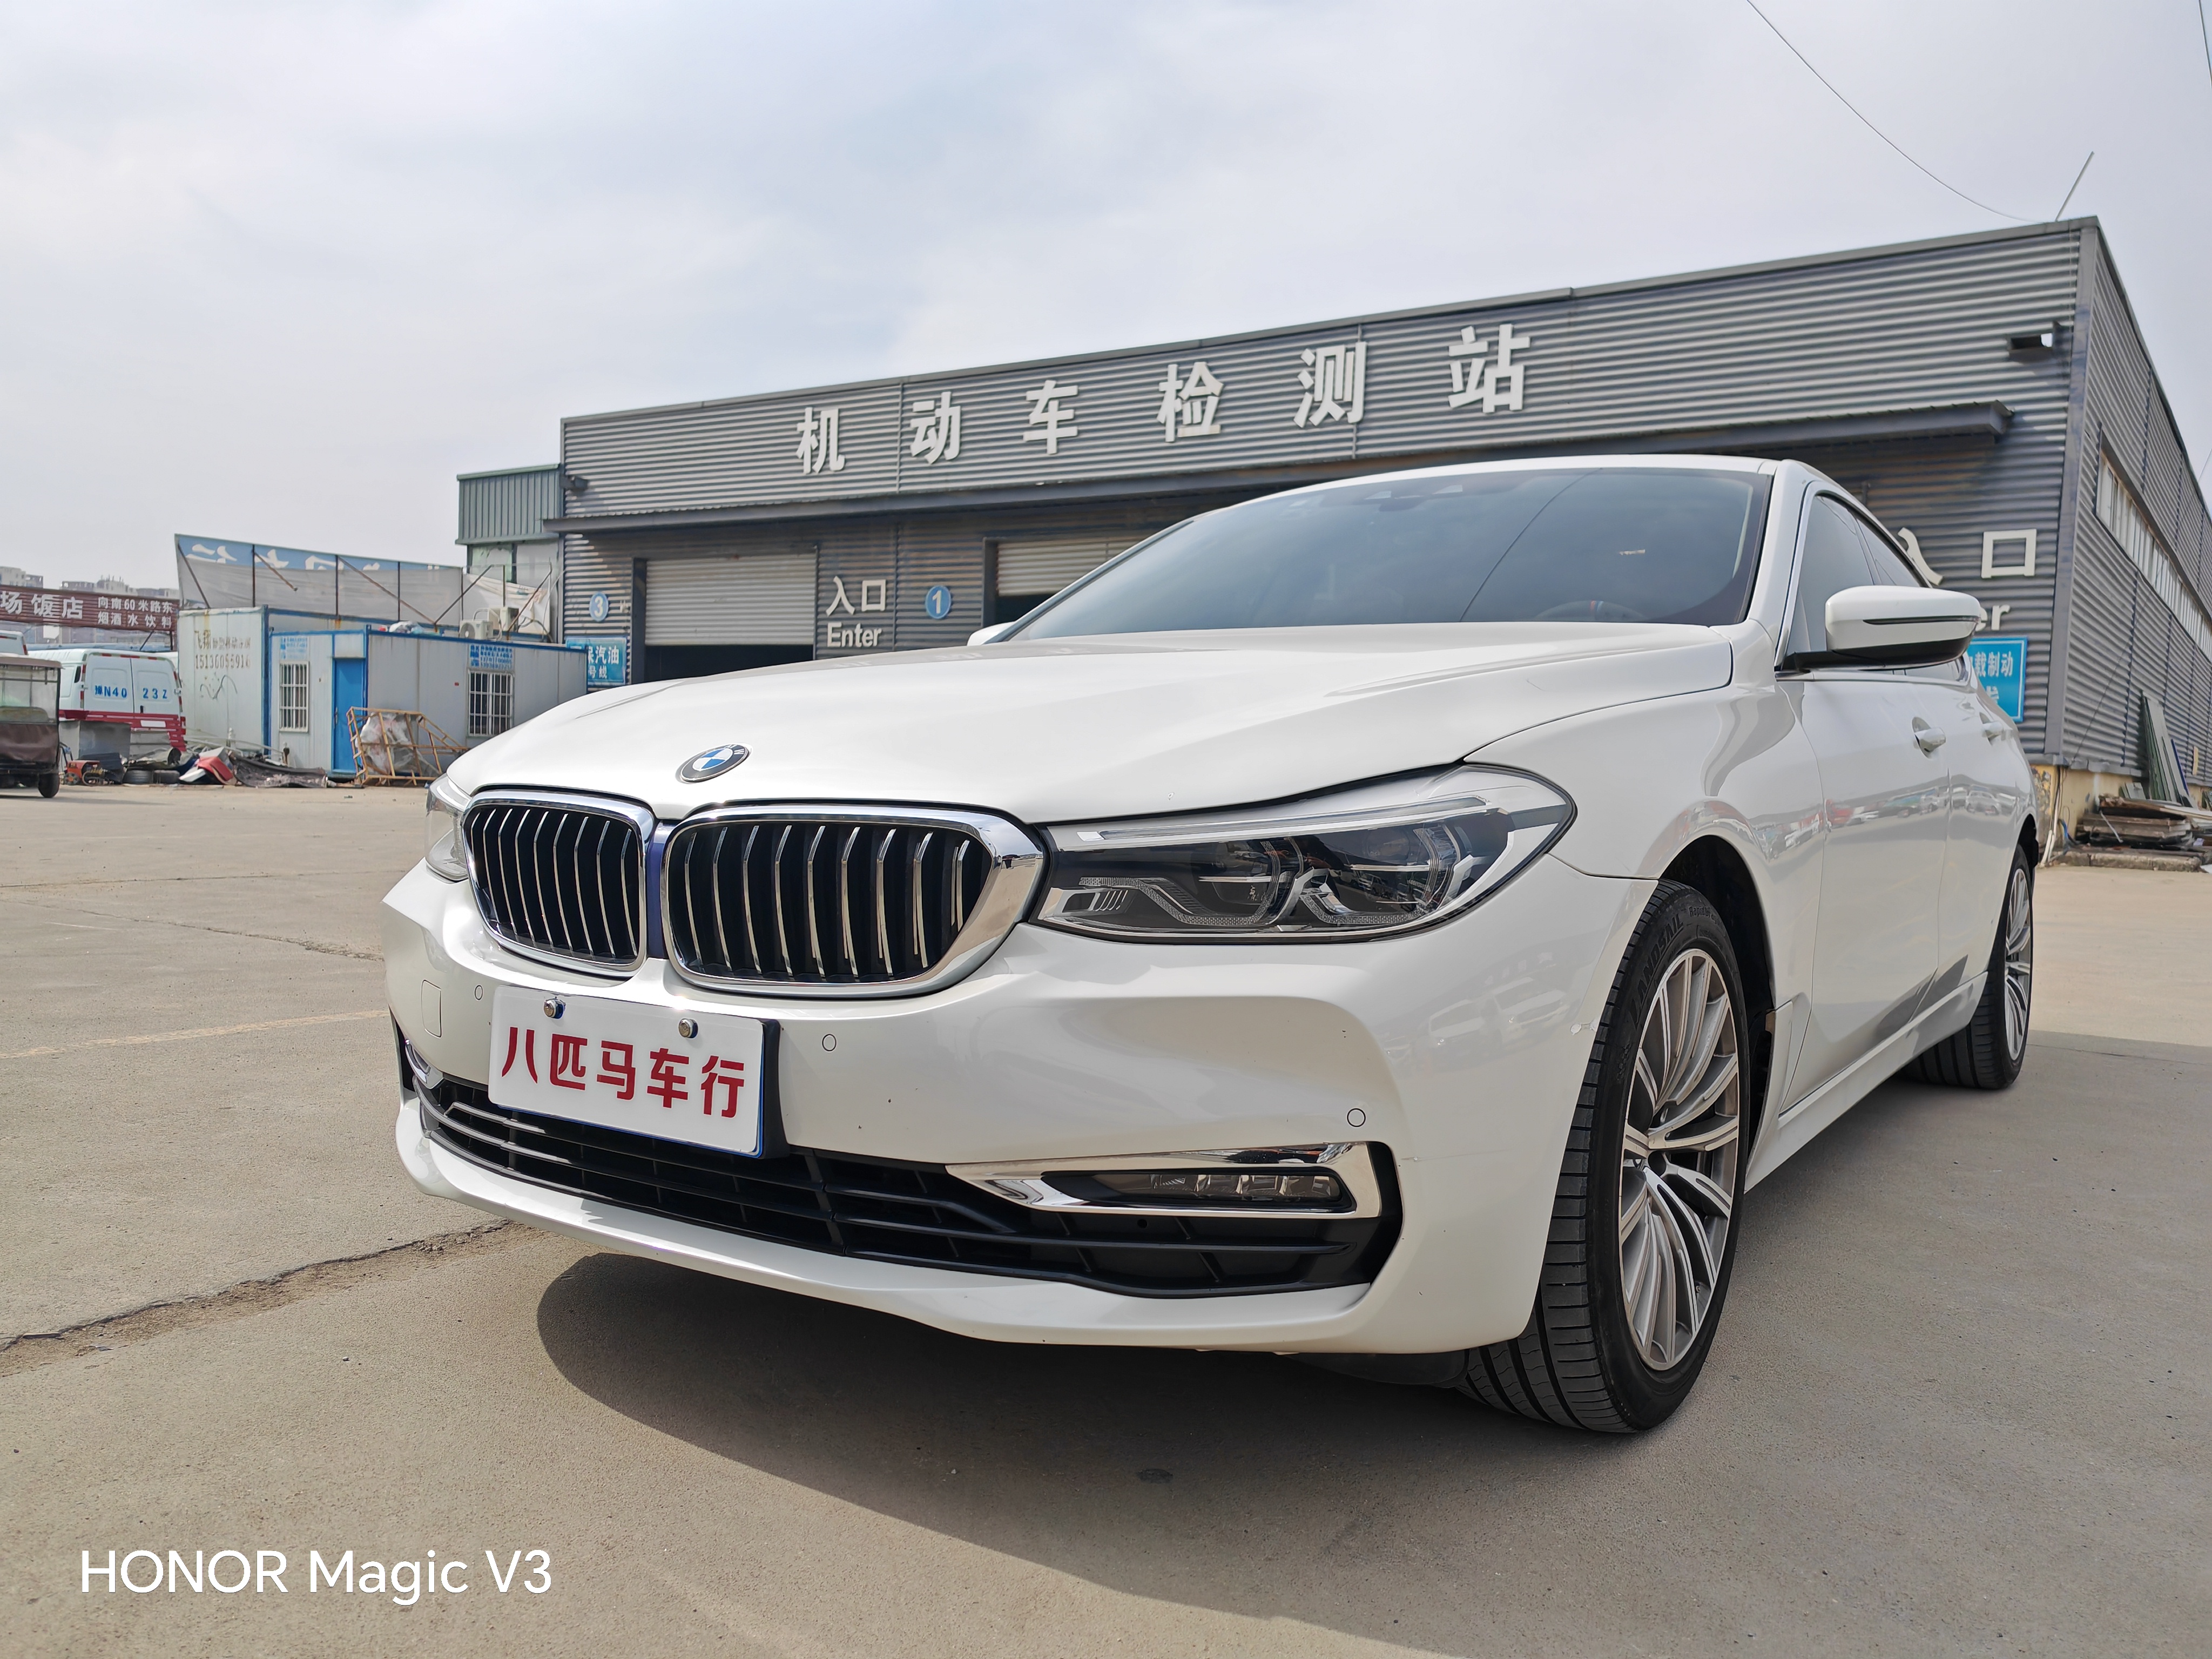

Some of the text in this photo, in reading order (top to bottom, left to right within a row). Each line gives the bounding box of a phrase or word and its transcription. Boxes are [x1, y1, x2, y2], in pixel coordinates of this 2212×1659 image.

[796, 323, 1530, 474] 机动车检测站
[594, 596, 603, 617] 3
[826, 576, 886, 617] 入口
[933, 590, 942, 614] 1
[98, 611, 172, 629] 烟酒水饮料
[827, 622, 882, 648] Enter
[1970, 651, 2013, 677] 载制动
[501, 1026, 745, 1118] 八匹马车行
